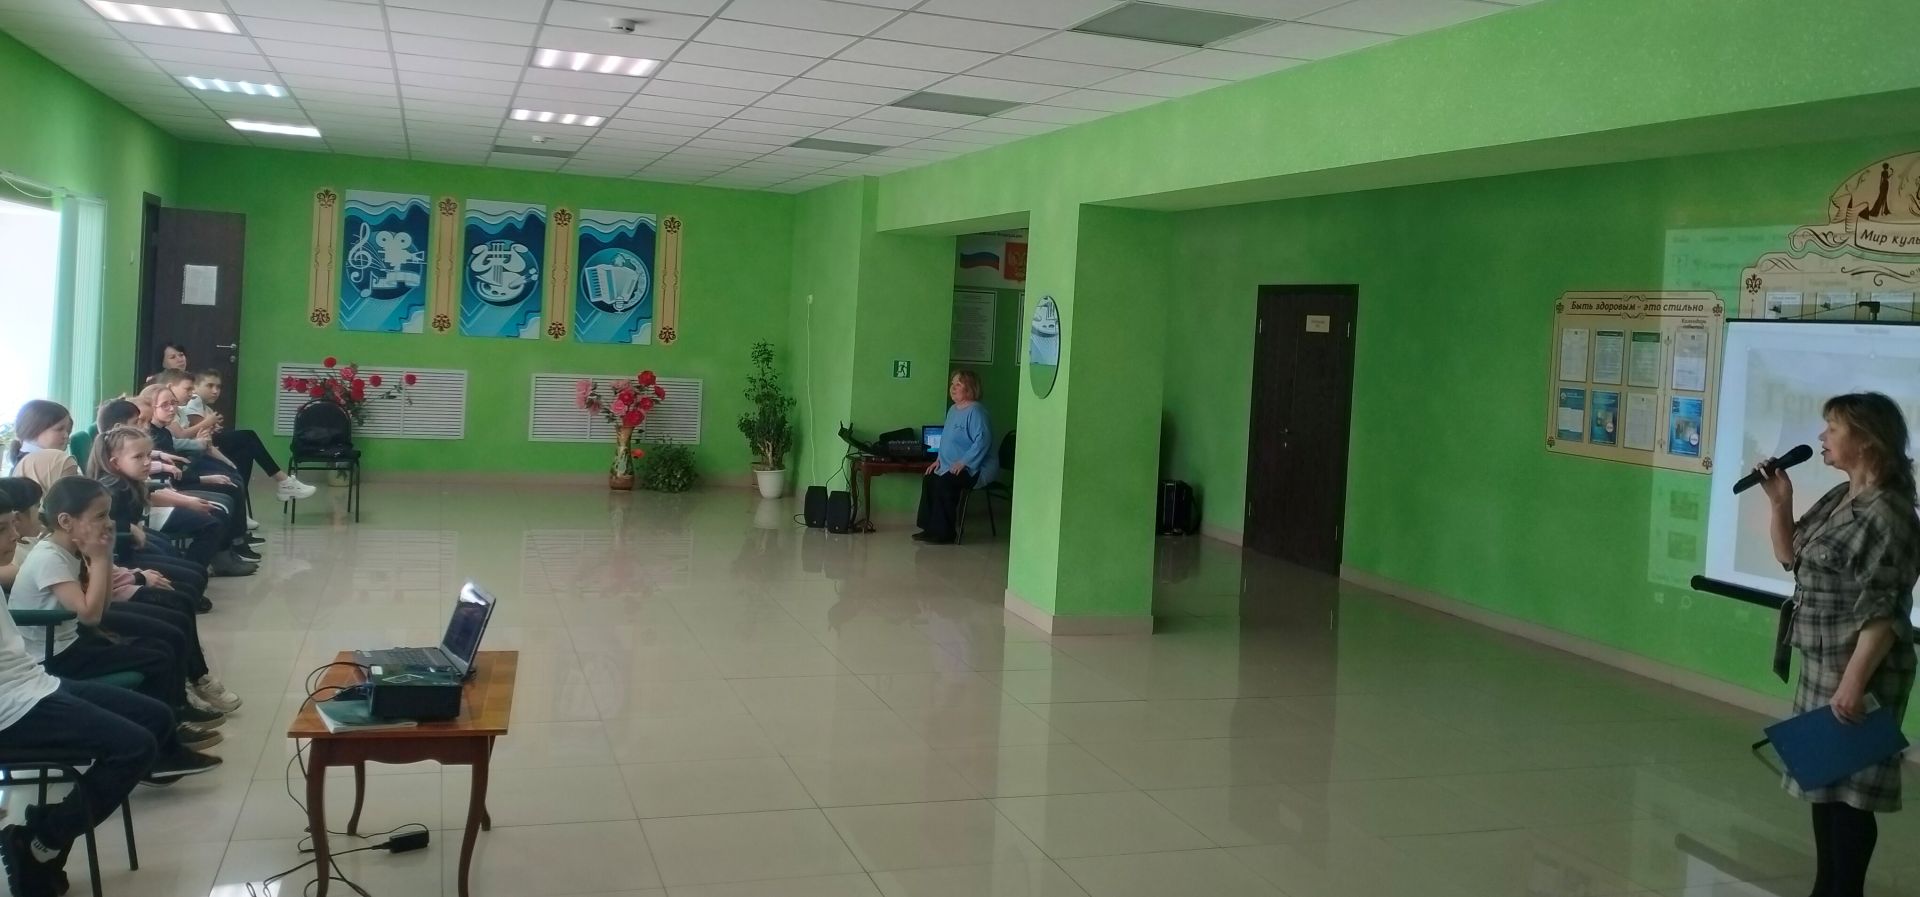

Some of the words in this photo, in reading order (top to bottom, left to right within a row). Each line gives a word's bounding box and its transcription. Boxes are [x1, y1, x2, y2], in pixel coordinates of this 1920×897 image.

[1860, 229, 1888, 246] Мир
[1569, 300, 1594, 311] Быть
[1595, 301, 1636, 313] здоровым
[1643, 303, 1662, 311] это
[1662, 303, 1704, 312] стильно
